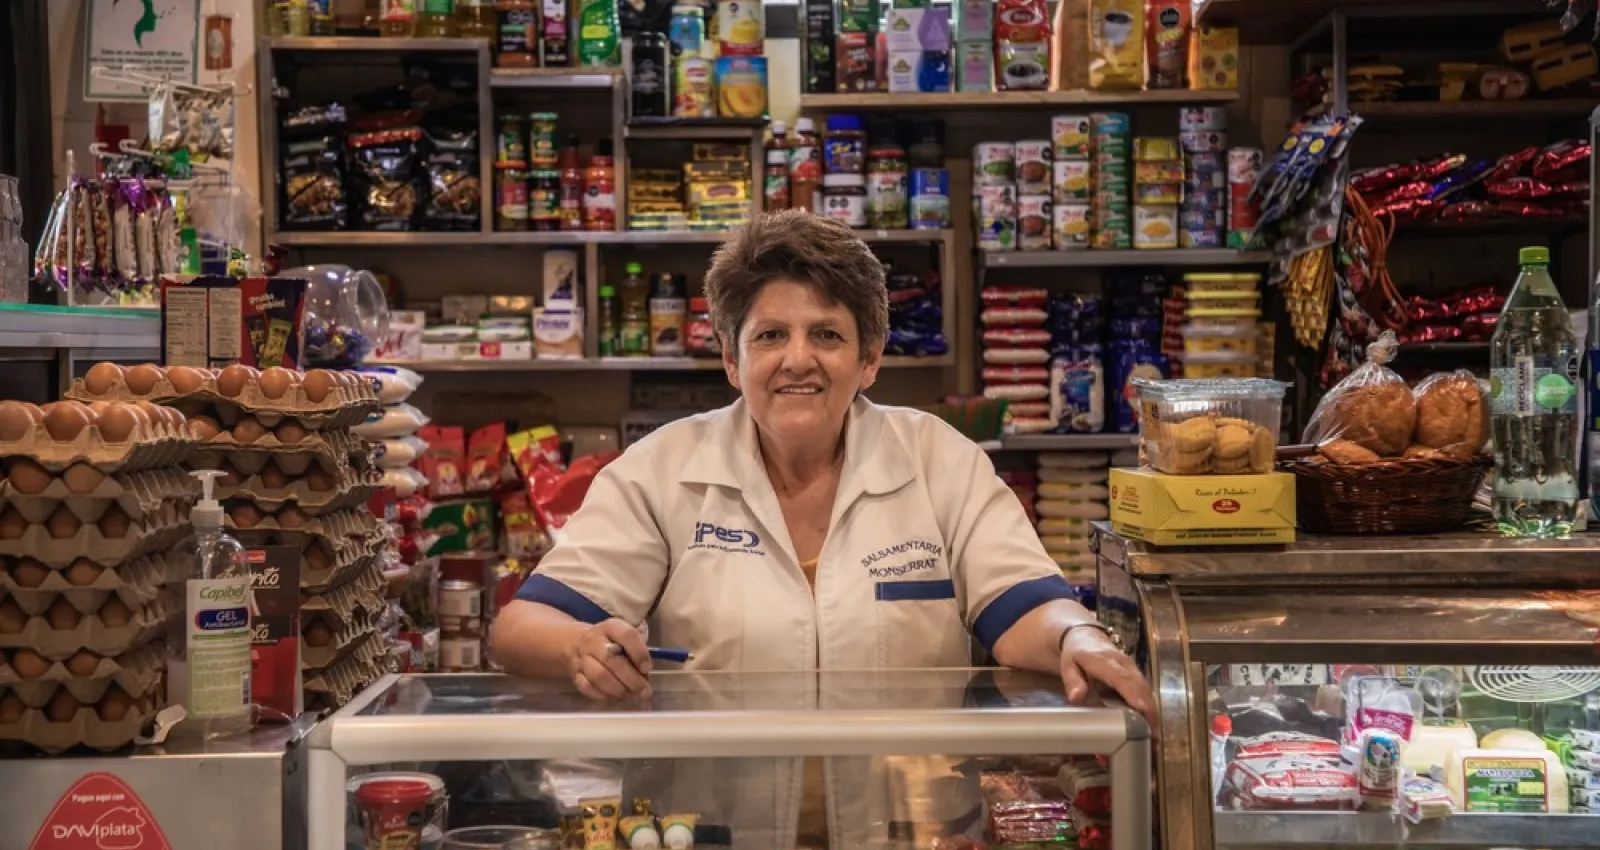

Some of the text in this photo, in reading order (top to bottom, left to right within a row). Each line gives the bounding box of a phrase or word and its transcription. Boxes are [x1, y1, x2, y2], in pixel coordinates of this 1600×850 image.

[861, 540, 942, 567] SALSAMENTARIA
[869, 558, 937, 578] MONSERRAT
[216, 611, 237, 621] GEL
